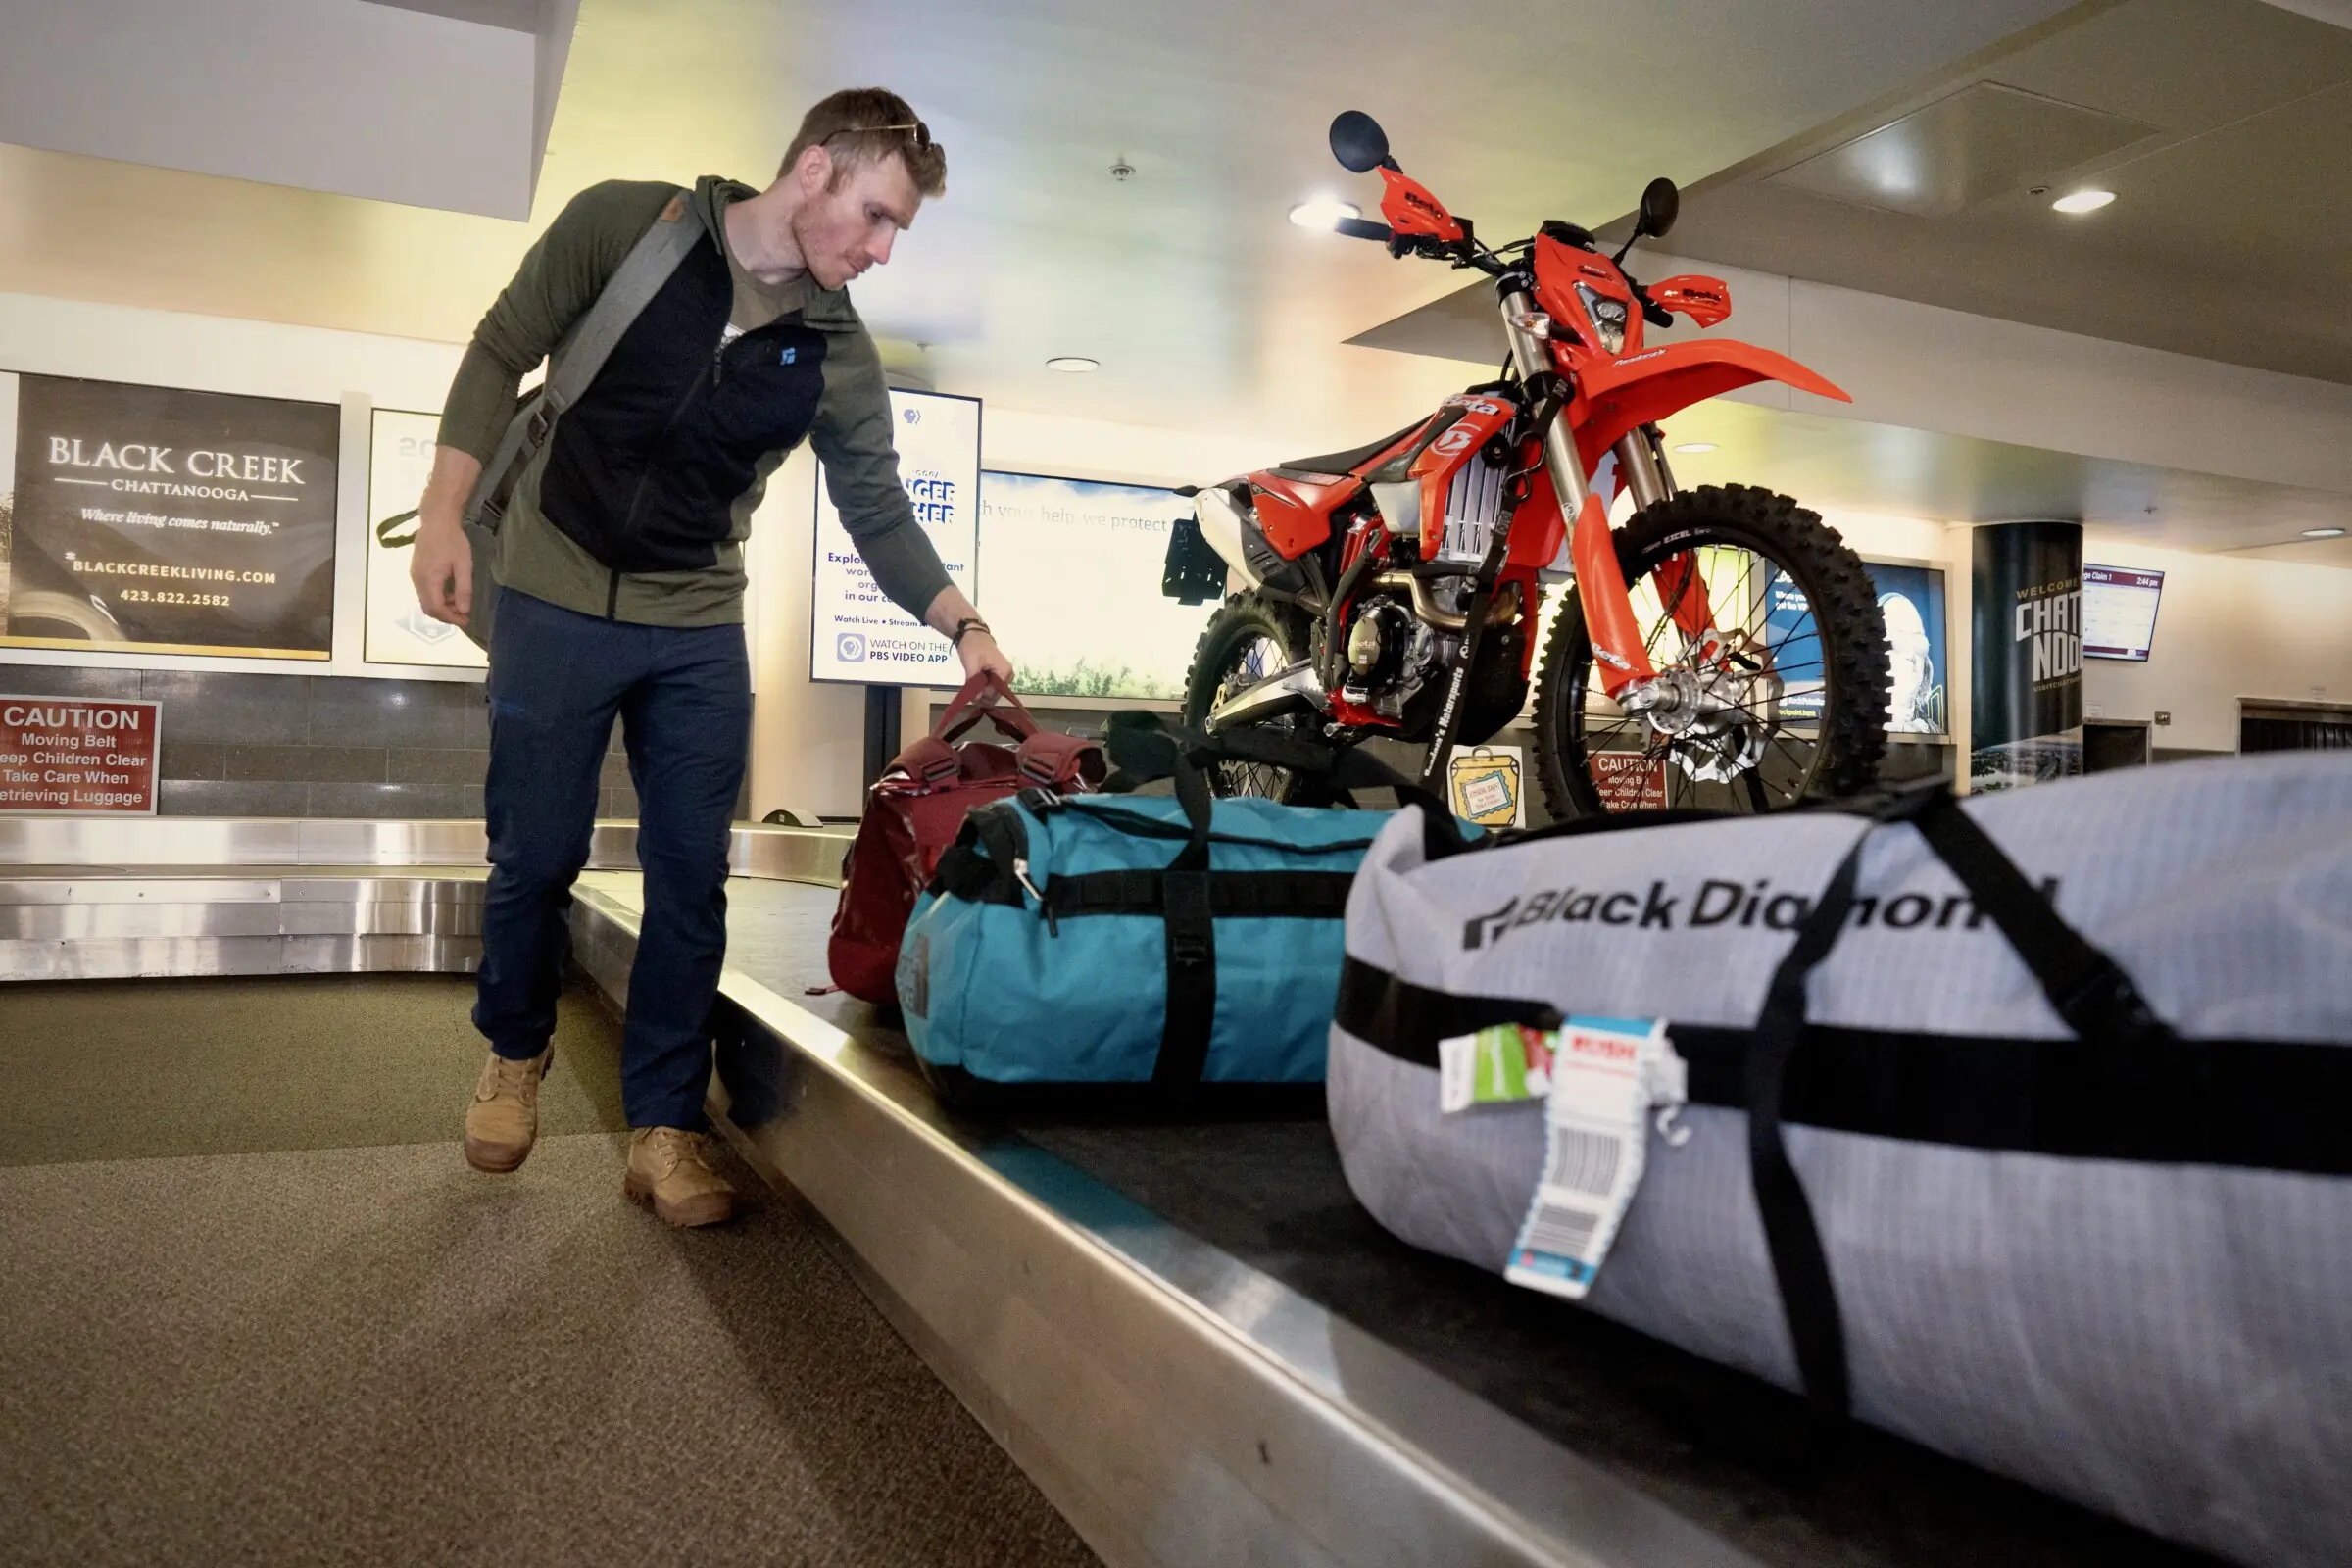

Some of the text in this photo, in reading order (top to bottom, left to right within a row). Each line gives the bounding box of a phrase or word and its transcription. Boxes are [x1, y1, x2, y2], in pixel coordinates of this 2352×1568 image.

[49, 436, 306, 485] BLACK CREEK
[111, 478, 249, 502] CHATTANOOGA
[81, 508, 124, 523] Where
[126, 511, 167, 528] living
[169, 516, 208, 529] comes
[1111, 515, 1167, 532] protect
[73, 560, 276, 584] BLACKCREEKLIVING.COM
[845, 590, 856, 600] in
[858, 593, 878, 602] our
[2016, 578, 2078, 599] WELCOME
[121, 590, 230, 607] 423.822.2582
[834, 615, 860, 624] Watch
[862, 616, 878, 625] Live
[889, 618, 918, 627] Stream
[870, 639, 948, 652] WATCH ON THE
[870, 651, 948, 663] PBS VIDEO APP
[4, 706, 139, 730] CAUTION
[22, 733, 117, 749] Moving Belt
[0, 752, 147, 766] eep Children Clear
[3, 769, 129, 784] Take Care When
[0, 789, 143, 805] etrieving Luggage
[1515, 878, 2060, 930] Black Diaon
